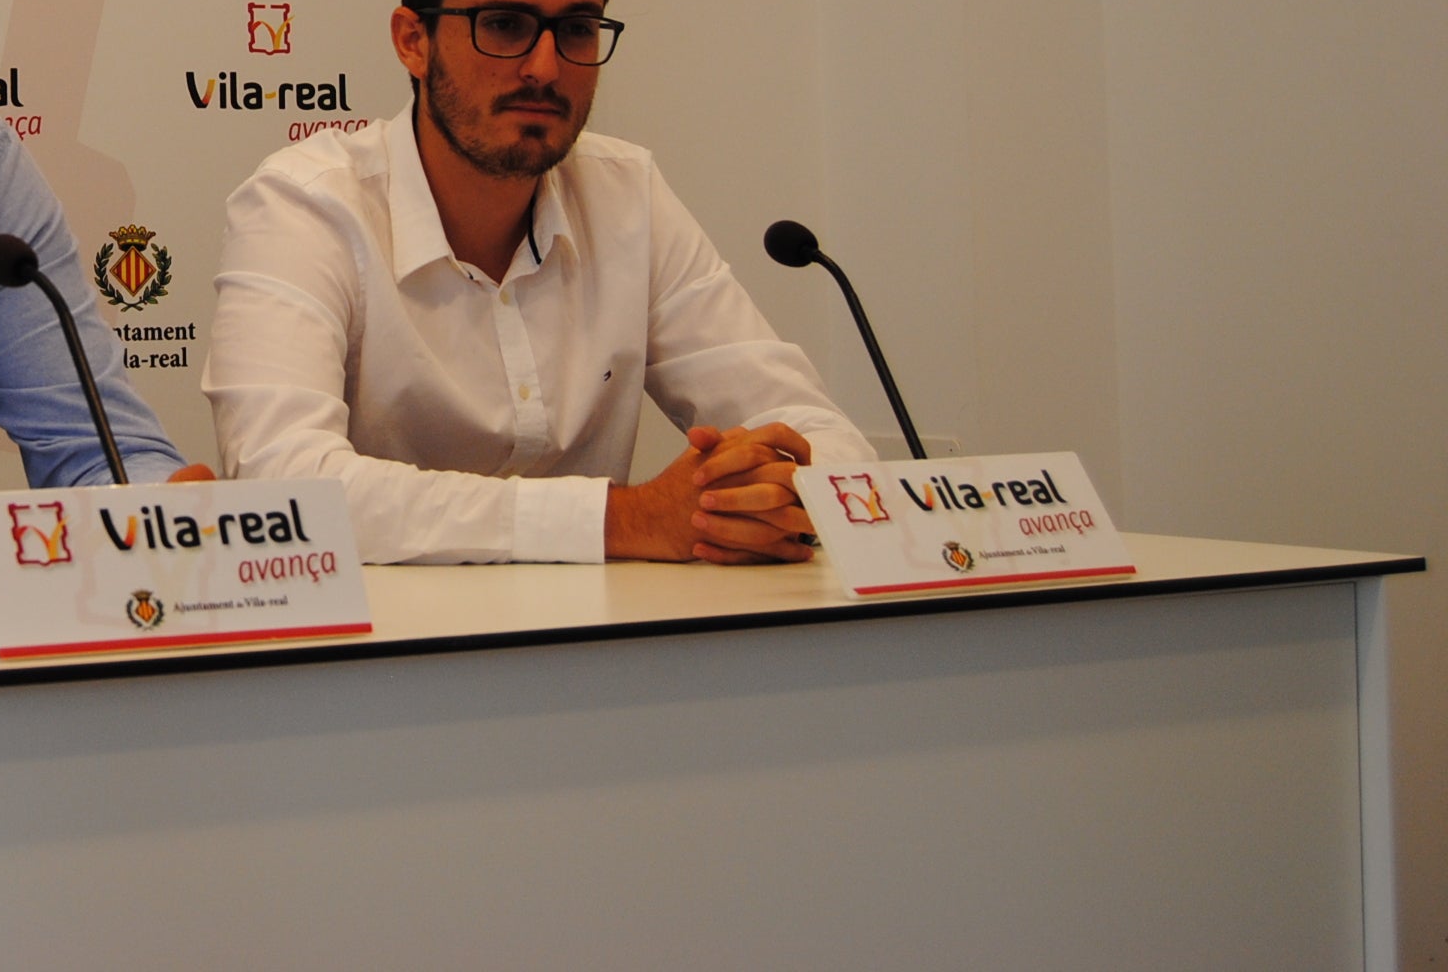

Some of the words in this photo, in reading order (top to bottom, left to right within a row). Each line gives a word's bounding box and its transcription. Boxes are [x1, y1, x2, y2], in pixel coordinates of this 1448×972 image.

[186, 72, 351, 111] Vila-real
[900, 470, 1066, 511] Vila-real
[100, 499, 309, 551] Vila-real
[1019, 511, 1094, 535] avança
[239, 551, 337, 584] avança
